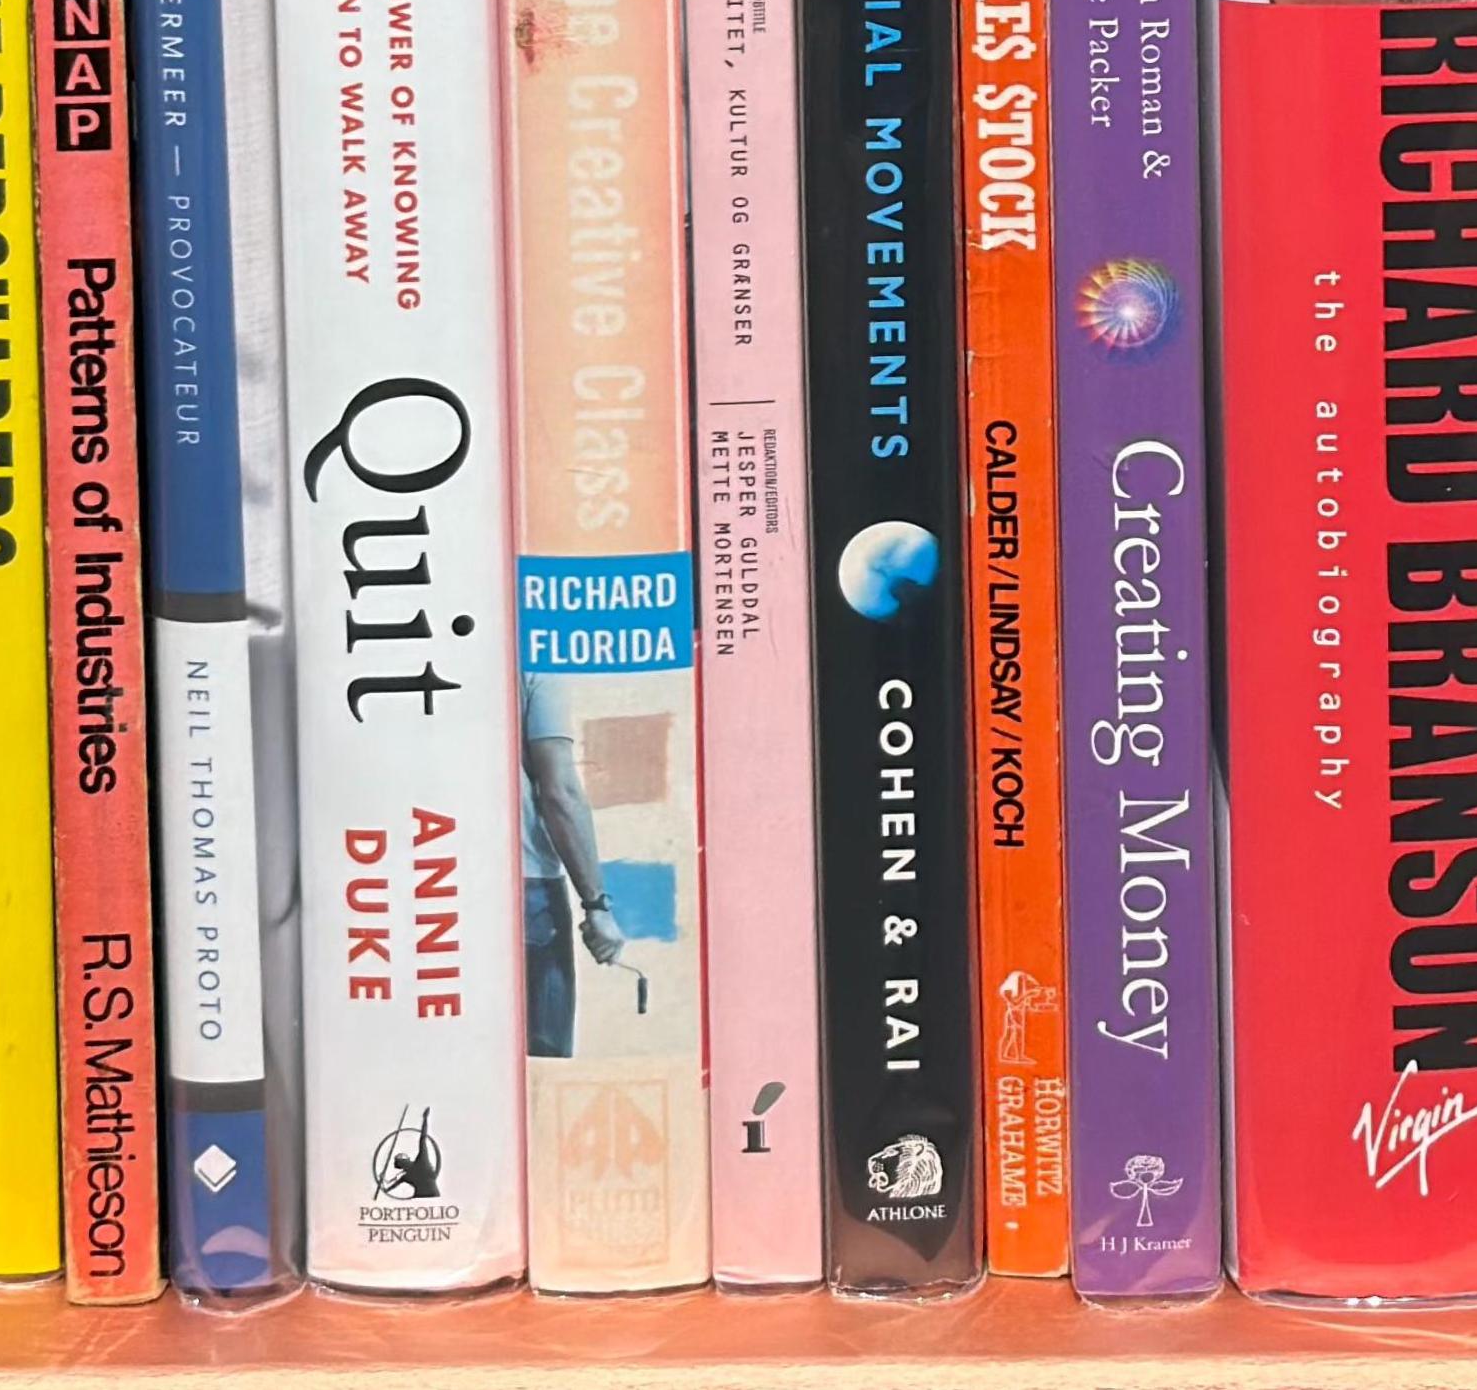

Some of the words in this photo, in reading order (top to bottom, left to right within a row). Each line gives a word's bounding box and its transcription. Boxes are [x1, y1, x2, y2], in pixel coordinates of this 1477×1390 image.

[339, 28, 363, 67] TO
[1089, 19, 1120, 128] Packer
[1141, 19, 1170, 136] Roman
[340, 83, 366, 174] WALK
[391, 85, 415, 126] OF
[729, 90, 747, 177] KULTUR
[732, 197, 749, 224] OG
[1142, 150, 1171, 178] &
[343, 189, 369, 283] AWAY
[393, 141, 420, 309] KNOWING
[167, 195, 200, 446] PROVOCATEUR
[865, 117, 907, 460] MOVEMENTS
[1314, 270, 1344, 352] the
[67, 258, 115, 465] Patterns
[72, 482, 122, 533] of
[711, 431, 730, 503] METTE
[738, 432, 757, 517] JESPER
[304, 377, 475, 723] Quit
[525, 573, 676, 609] RICHARD
[714, 523, 734, 655] MORTENSEN
[740, 538, 760, 638] GULDDAL
[530, 629, 675, 664] FLORIDA
[1091, 441, 1189, 767] Creating
[1312, 401, 1349, 809] autobiography
[75, 553, 128, 795] Industries
[187, 661, 208, 737] NEIL
[878, 679, 917, 881] COHEN
[190, 758, 217, 905] THOMAS
[884, 915, 918, 946] &
[1097, 790, 1190, 1060] Money
[198, 927, 221, 1042] PROTO
[885, 978, 921, 1070] RAI
[998, 1076, 1027, 1207] GRAHAME
[1033, 1077, 1064, 1196] HORWITZ
[360, 1206, 459, 1222] PORTFOLIO
[368, 1227, 451, 1243] PENGUIN
[867, 1204, 947, 1222] ATHLONE
